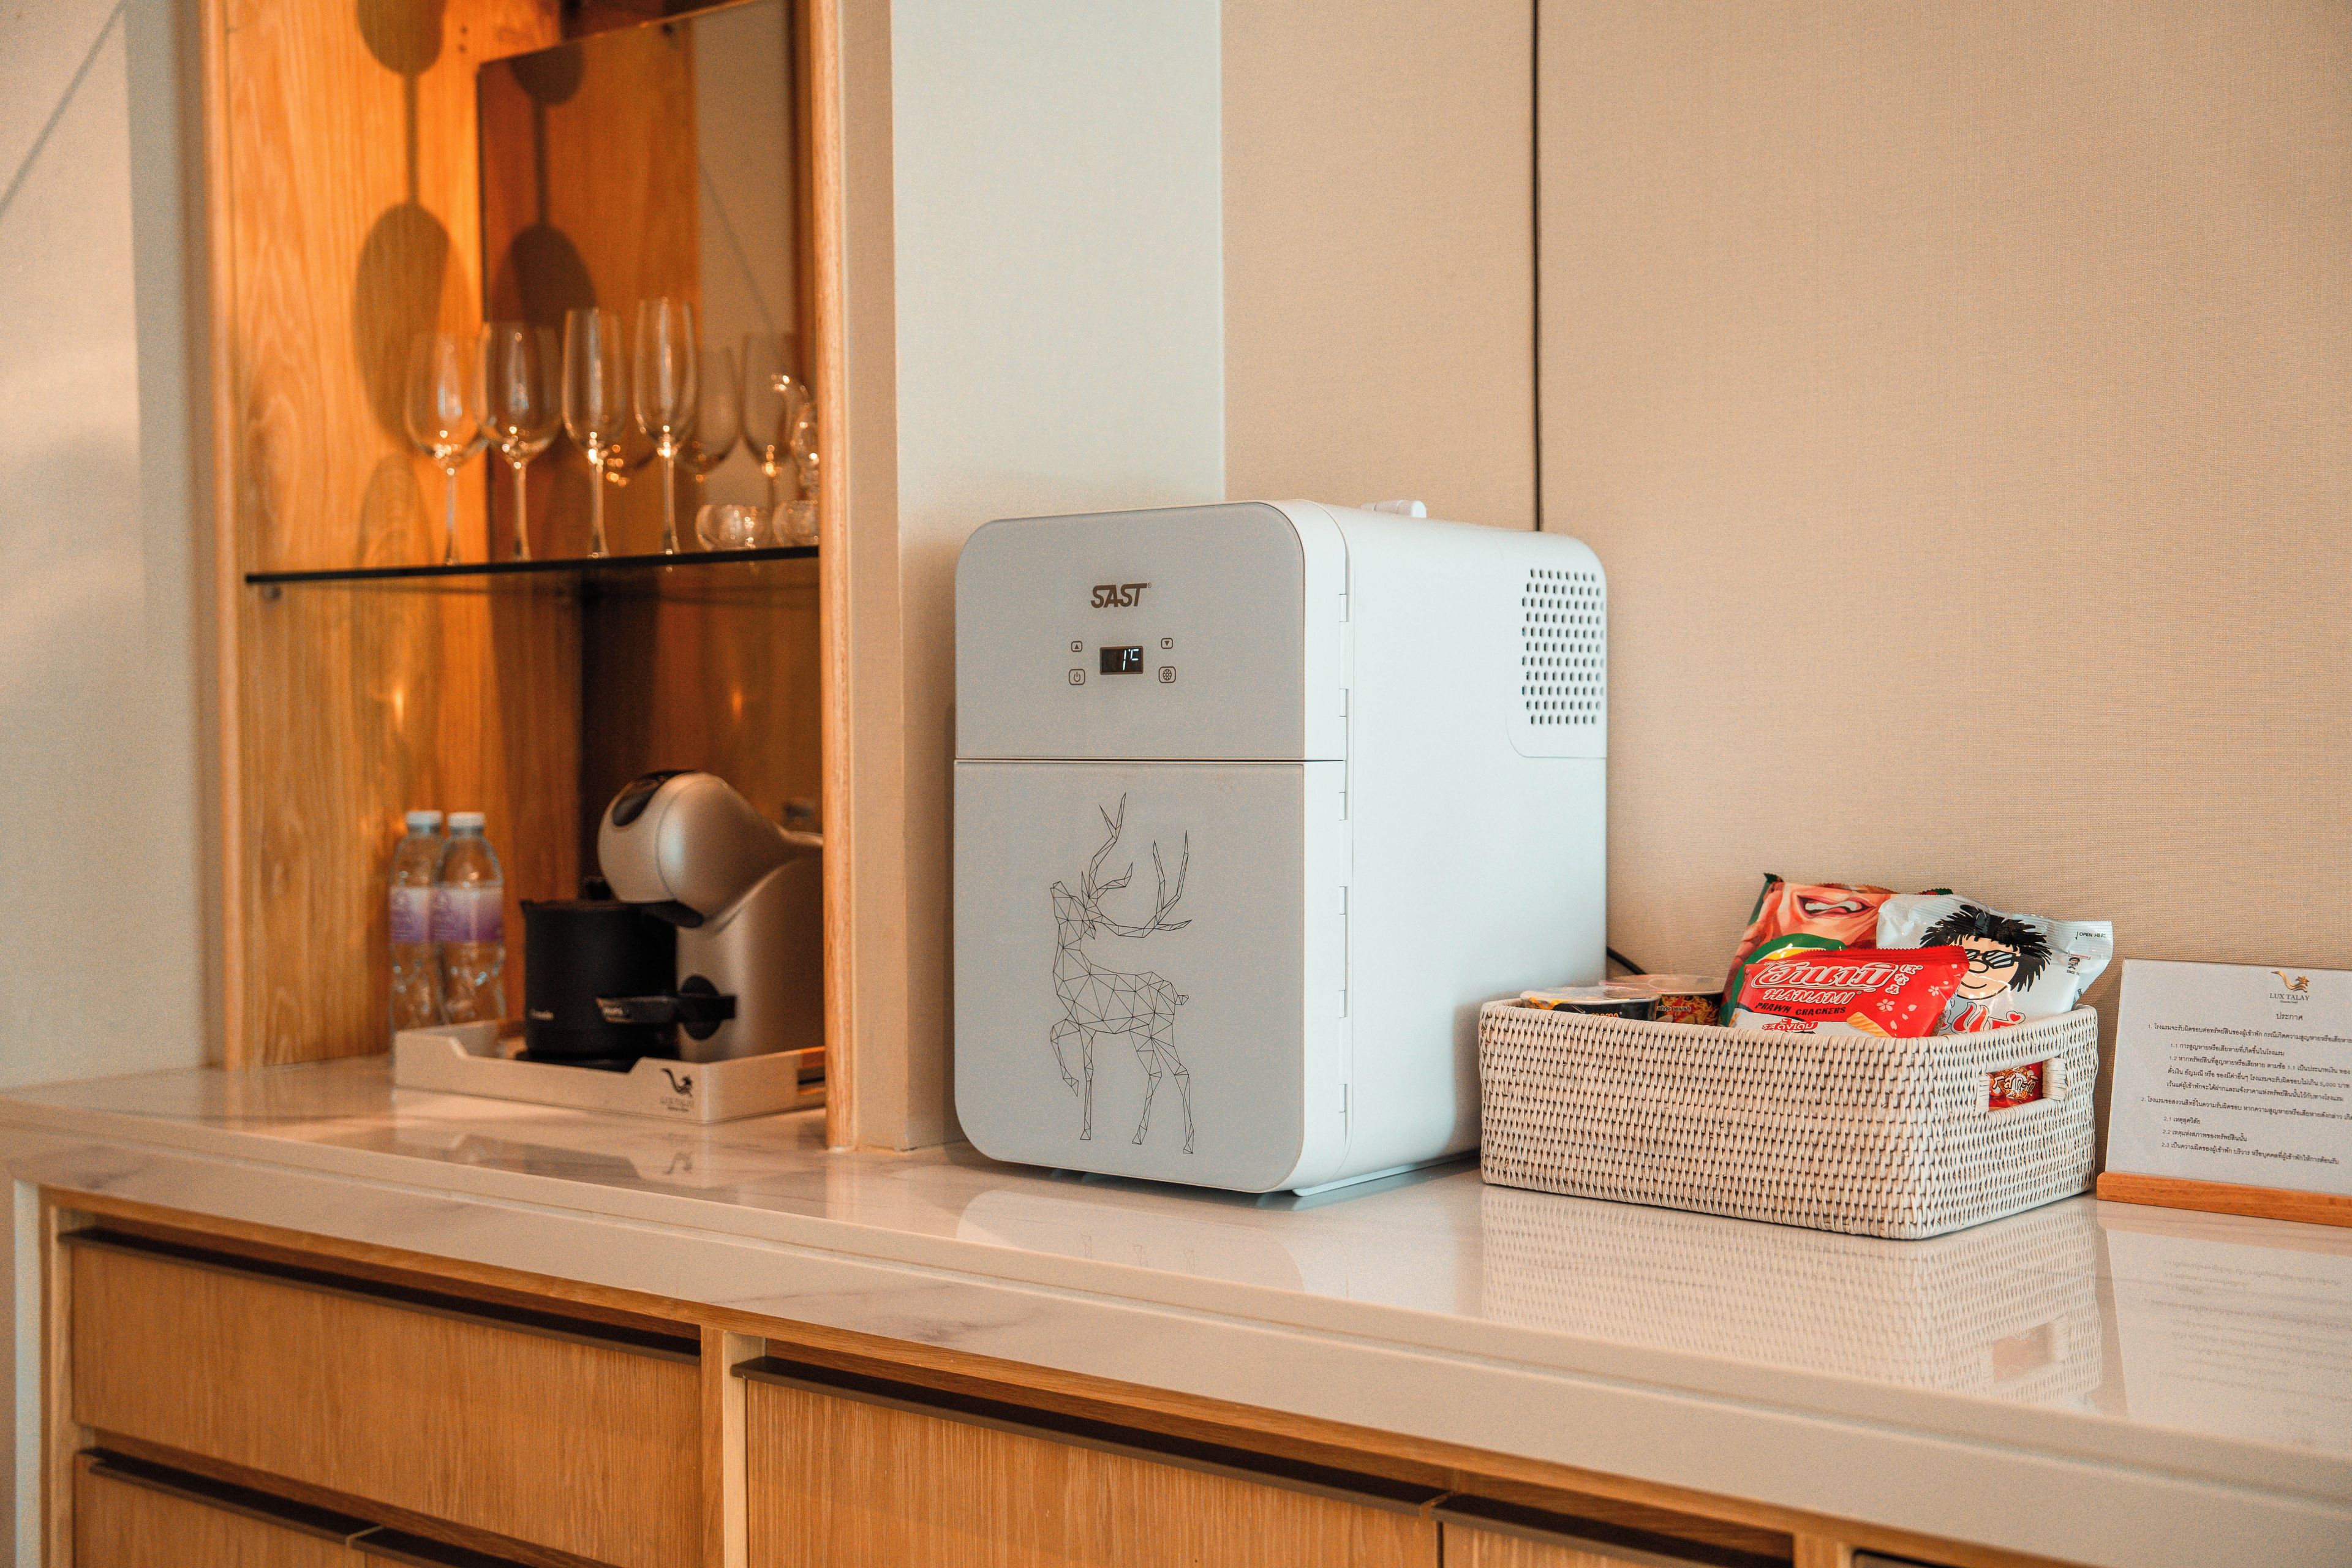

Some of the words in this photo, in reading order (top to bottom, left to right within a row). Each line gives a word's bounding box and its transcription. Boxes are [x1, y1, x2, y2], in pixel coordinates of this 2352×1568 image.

[1090, 582, 1148, 609] SAST
[1762, 989, 1858, 1005] HANAMI
[1755, 1003, 1791, 1013] PRAWN
[1795, 1006, 1845, 1016] CRACKERS
[2276, 1012, 2303, 1021] ประกาศ
